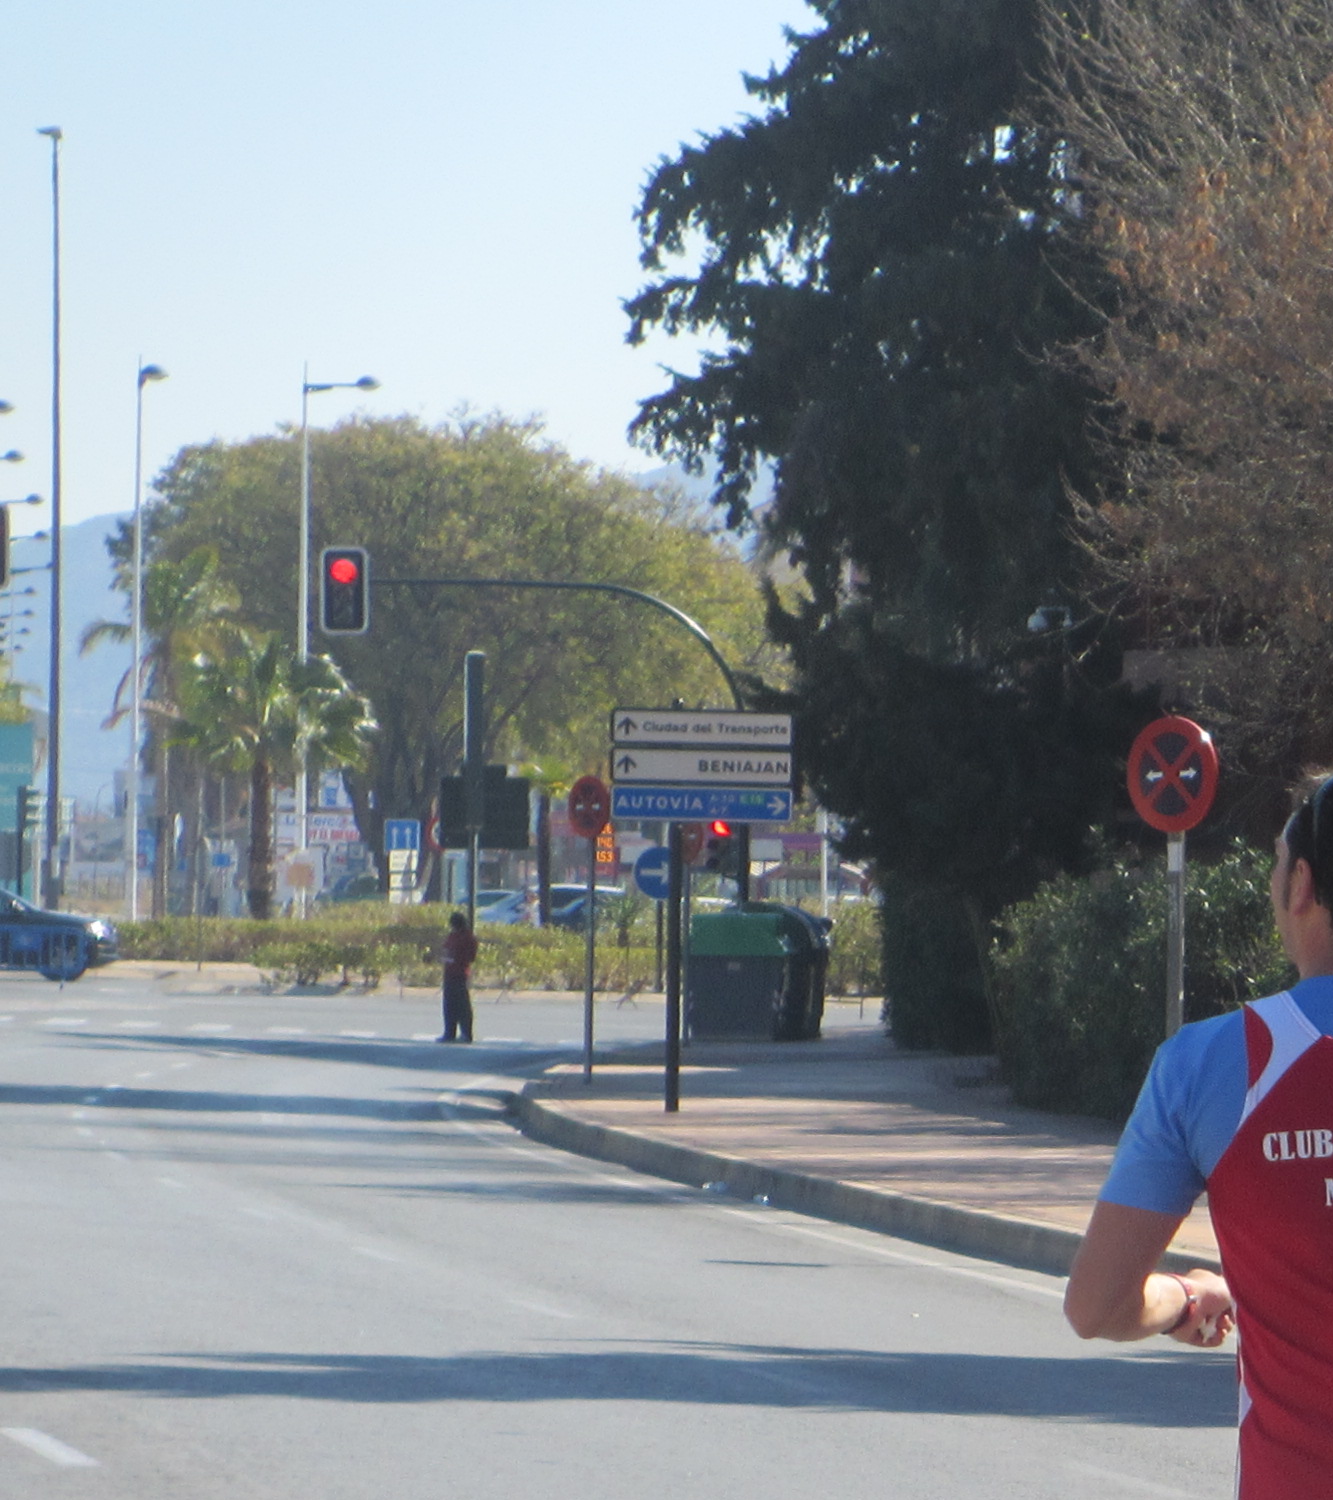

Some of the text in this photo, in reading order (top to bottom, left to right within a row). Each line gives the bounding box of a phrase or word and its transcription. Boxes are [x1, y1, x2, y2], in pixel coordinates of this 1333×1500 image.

[643, 721, 788, 738] Ciudad del Transporte
[698, 760, 788, 773] BENIAJAN
[616, 794, 703, 810] AUTOVÍA
